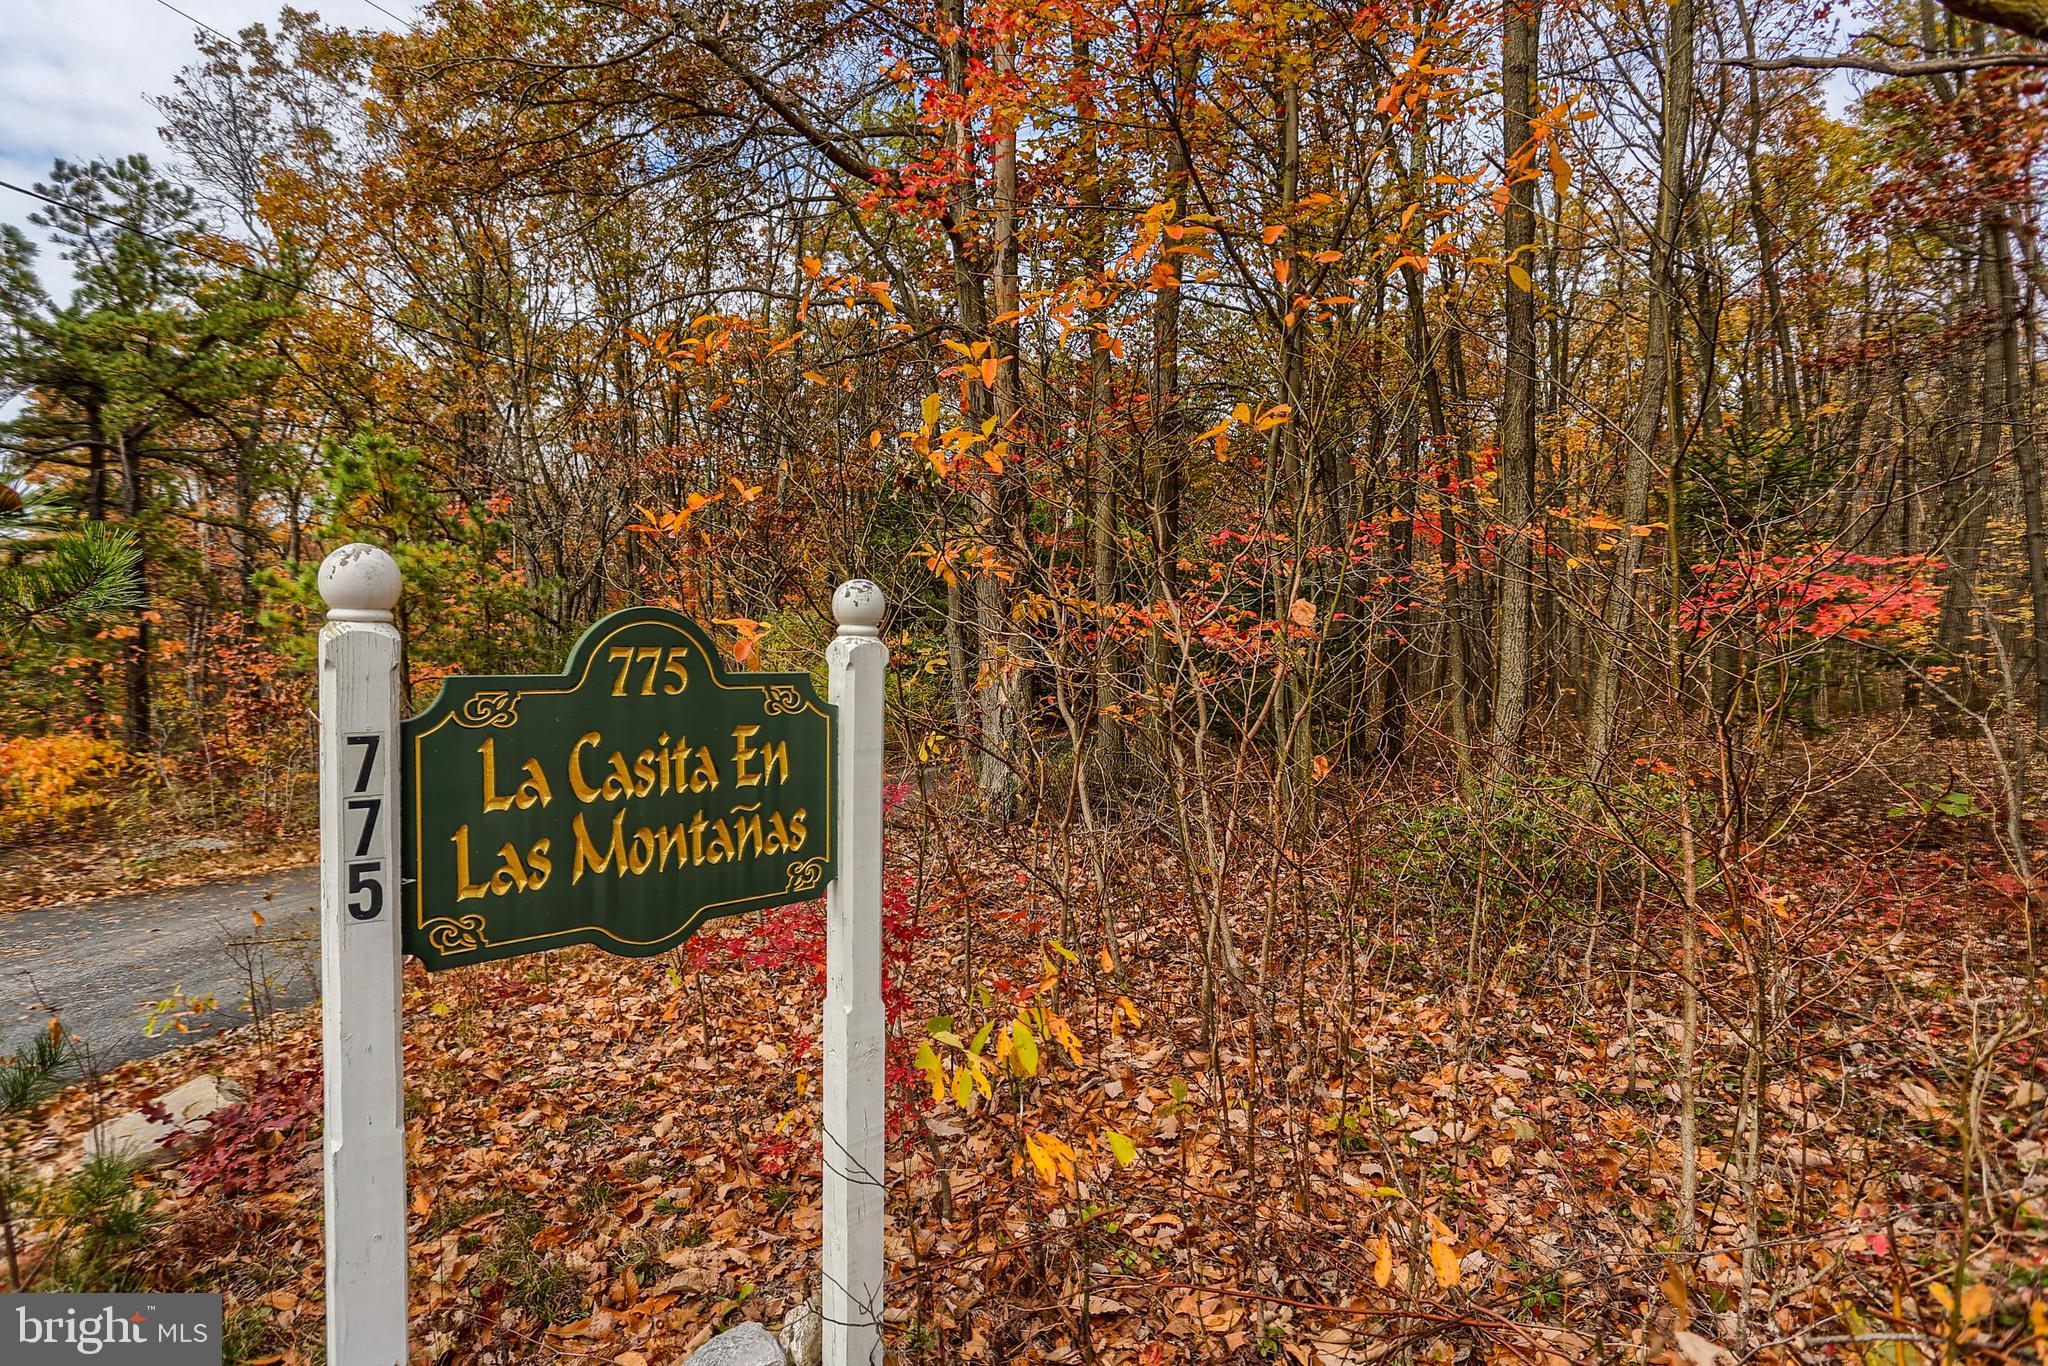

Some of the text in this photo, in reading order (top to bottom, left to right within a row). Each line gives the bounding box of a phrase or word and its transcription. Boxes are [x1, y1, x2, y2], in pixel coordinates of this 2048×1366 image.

[607, 646, 689, 697] 775
[476, 724, 790, 813] La Casita En
[346, 736, 385, 921] 775
[450, 801, 809, 902] Las Montañas
